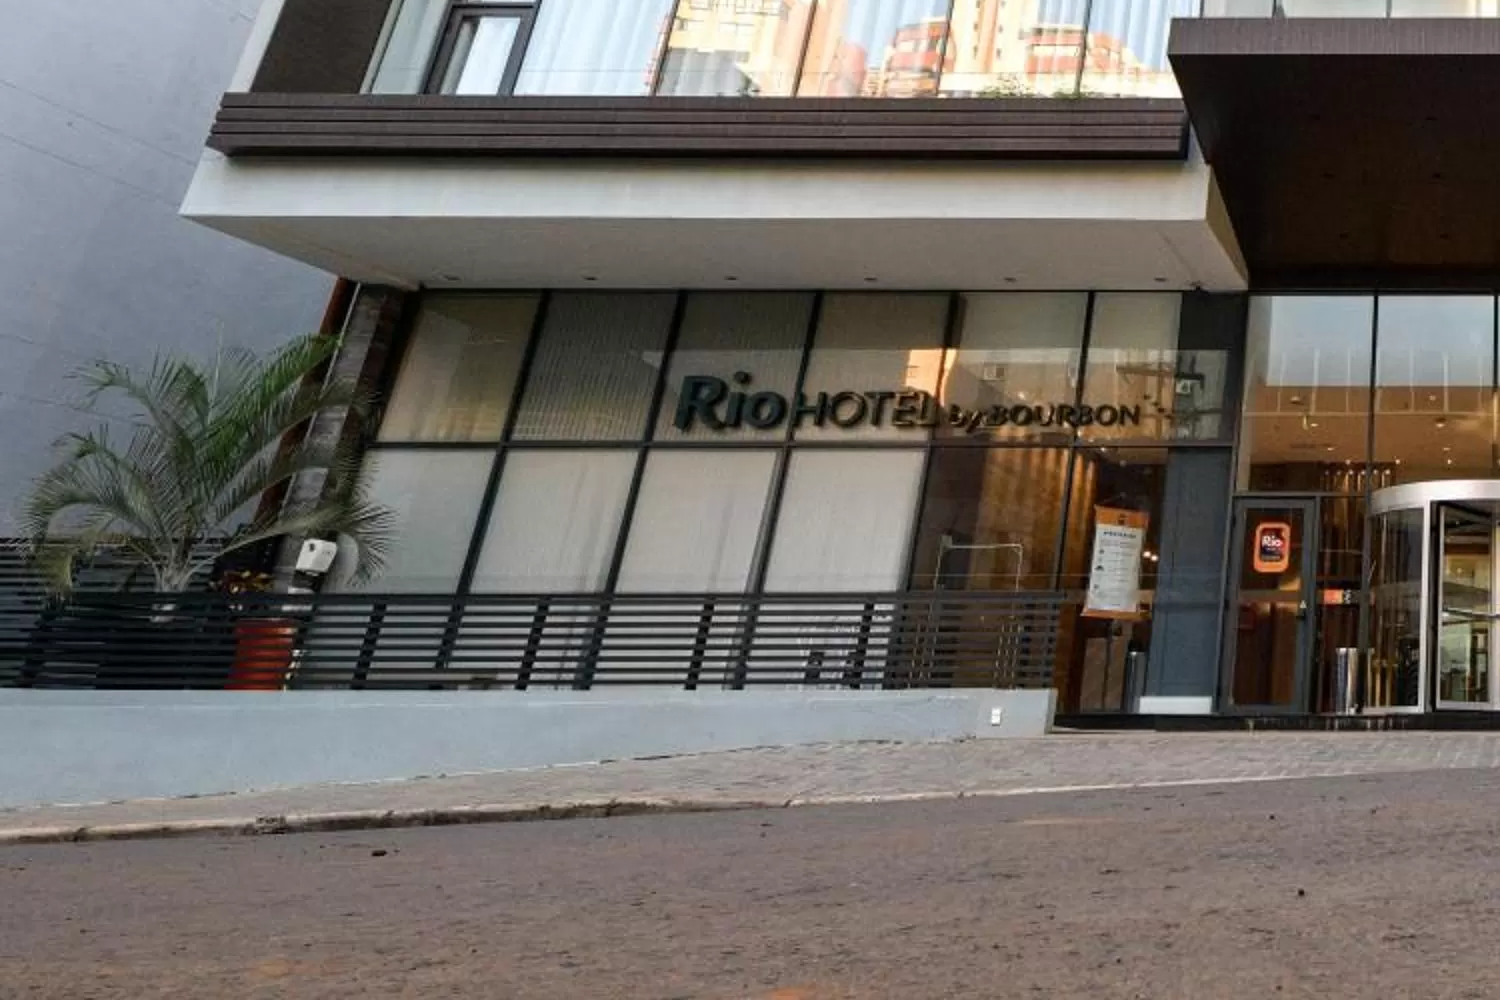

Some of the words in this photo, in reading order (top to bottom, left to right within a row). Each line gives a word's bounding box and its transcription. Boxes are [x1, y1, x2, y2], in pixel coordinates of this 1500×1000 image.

[674, 370, 788, 433] Rio
[794, 391, 938, 428] HOTEL
[949, 404, 983, 433] by
[990, 404, 1141, 427] BOURBON
